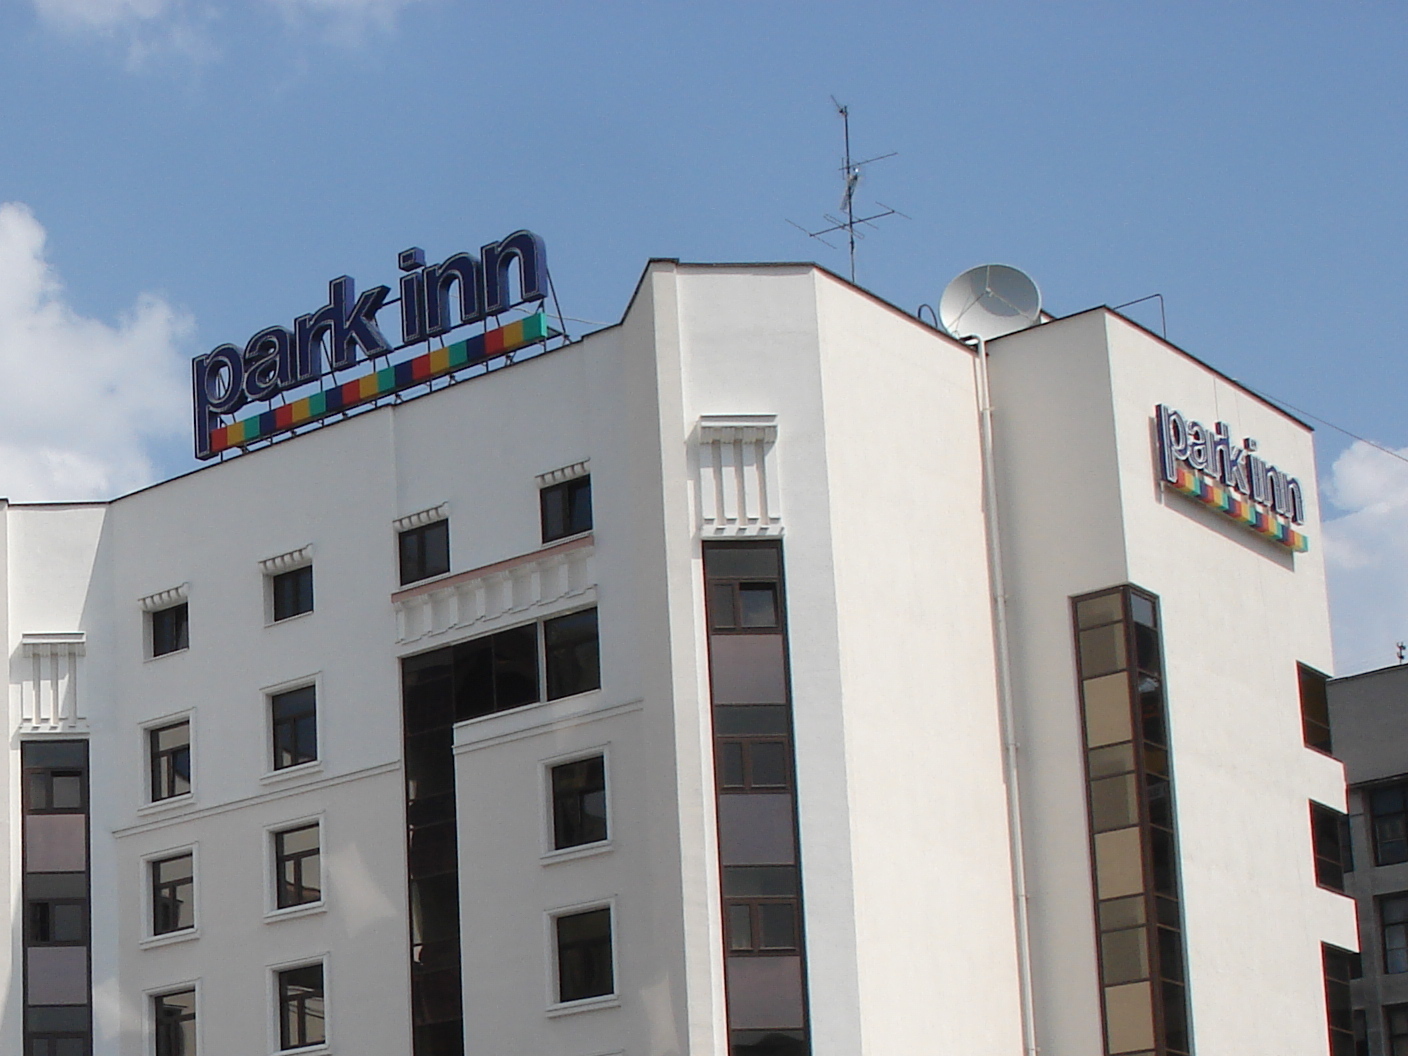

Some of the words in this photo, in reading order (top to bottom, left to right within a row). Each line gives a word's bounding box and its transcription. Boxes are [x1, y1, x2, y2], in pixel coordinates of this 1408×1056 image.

[192, 275, 391, 460] park
[398, 229, 548, 345] inn
[1155, 403, 1249, 495] park
[1243, 437, 1304, 526] inn
